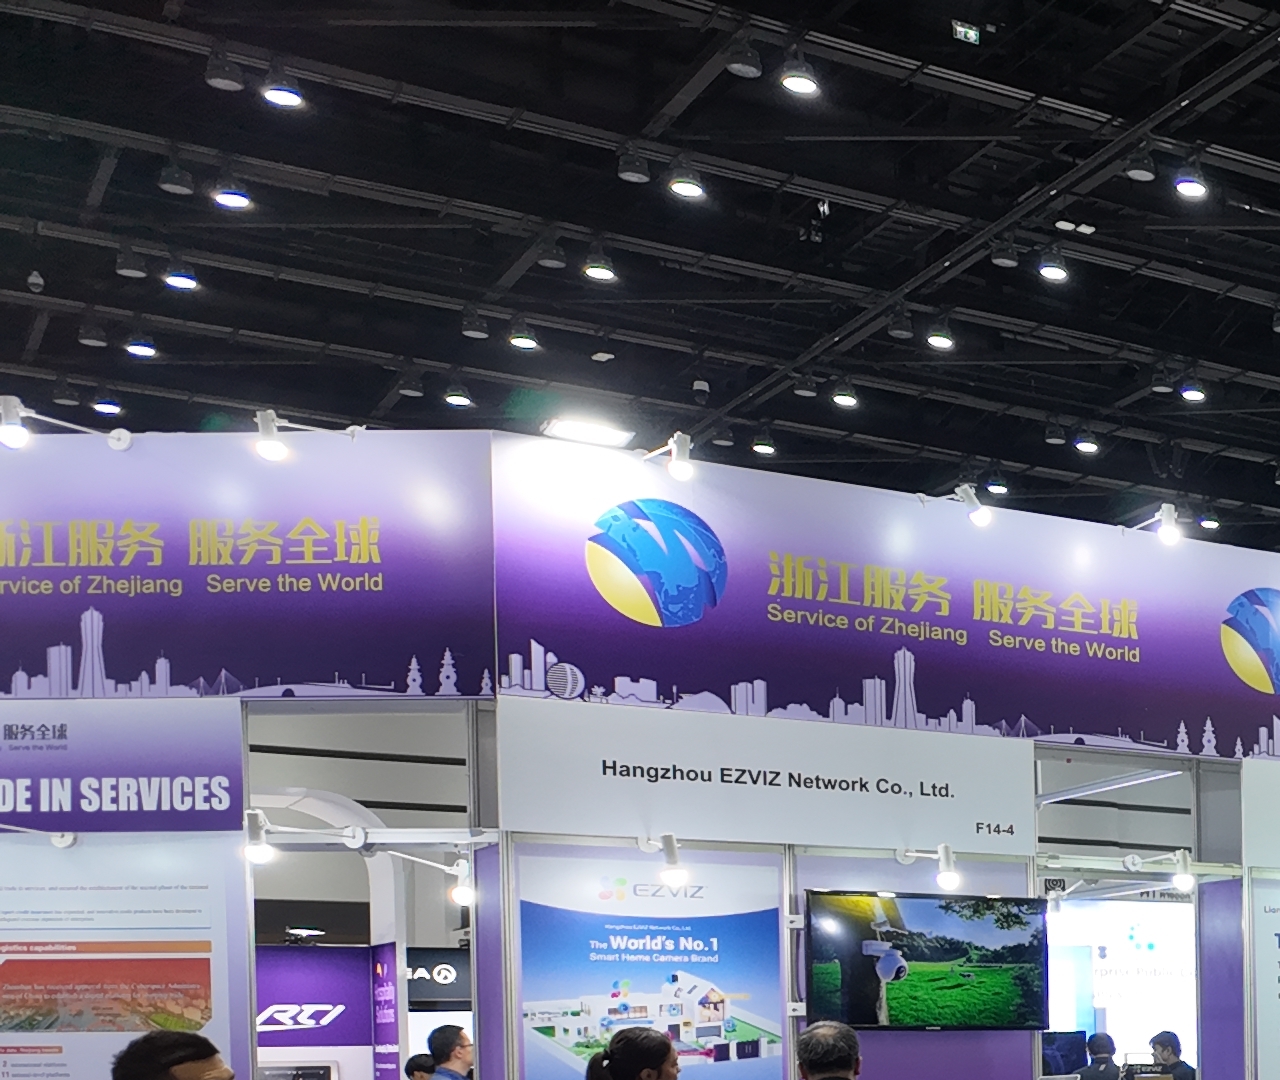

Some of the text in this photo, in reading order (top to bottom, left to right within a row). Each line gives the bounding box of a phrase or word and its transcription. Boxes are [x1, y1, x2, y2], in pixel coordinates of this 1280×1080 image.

[188, 515, 381, 566] 服务全球
[60, 575, 81, 595] of
[87, 575, 183, 597] Zhejiang
[206, 574, 271, 593] Serve
[277, 573, 312, 592] the
[317, 572, 384, 592] World
[767, 550, 1140, 641] 浙江服务 服务全球
[767, 604, 1140, 663] Service of Zhejiang Serve the World
[3, 723, 68, 741] 服务全球
[601, 759, 956, 800] Hangzhou EZVIZ Network Co., Ltd.
[39, 778, 72, 812] IN
[79, 775, 231, 812] SERVICES
[975, 822, 1016, 836] F14-4
[633, 883, 704, 899] EZVIZ
[589, 934, 718, 951] The World's No.1
[589, 952, 619, 961] Smart
[652, 953, 689, 962] Camera
[690, 954, 719, 963] Brand
